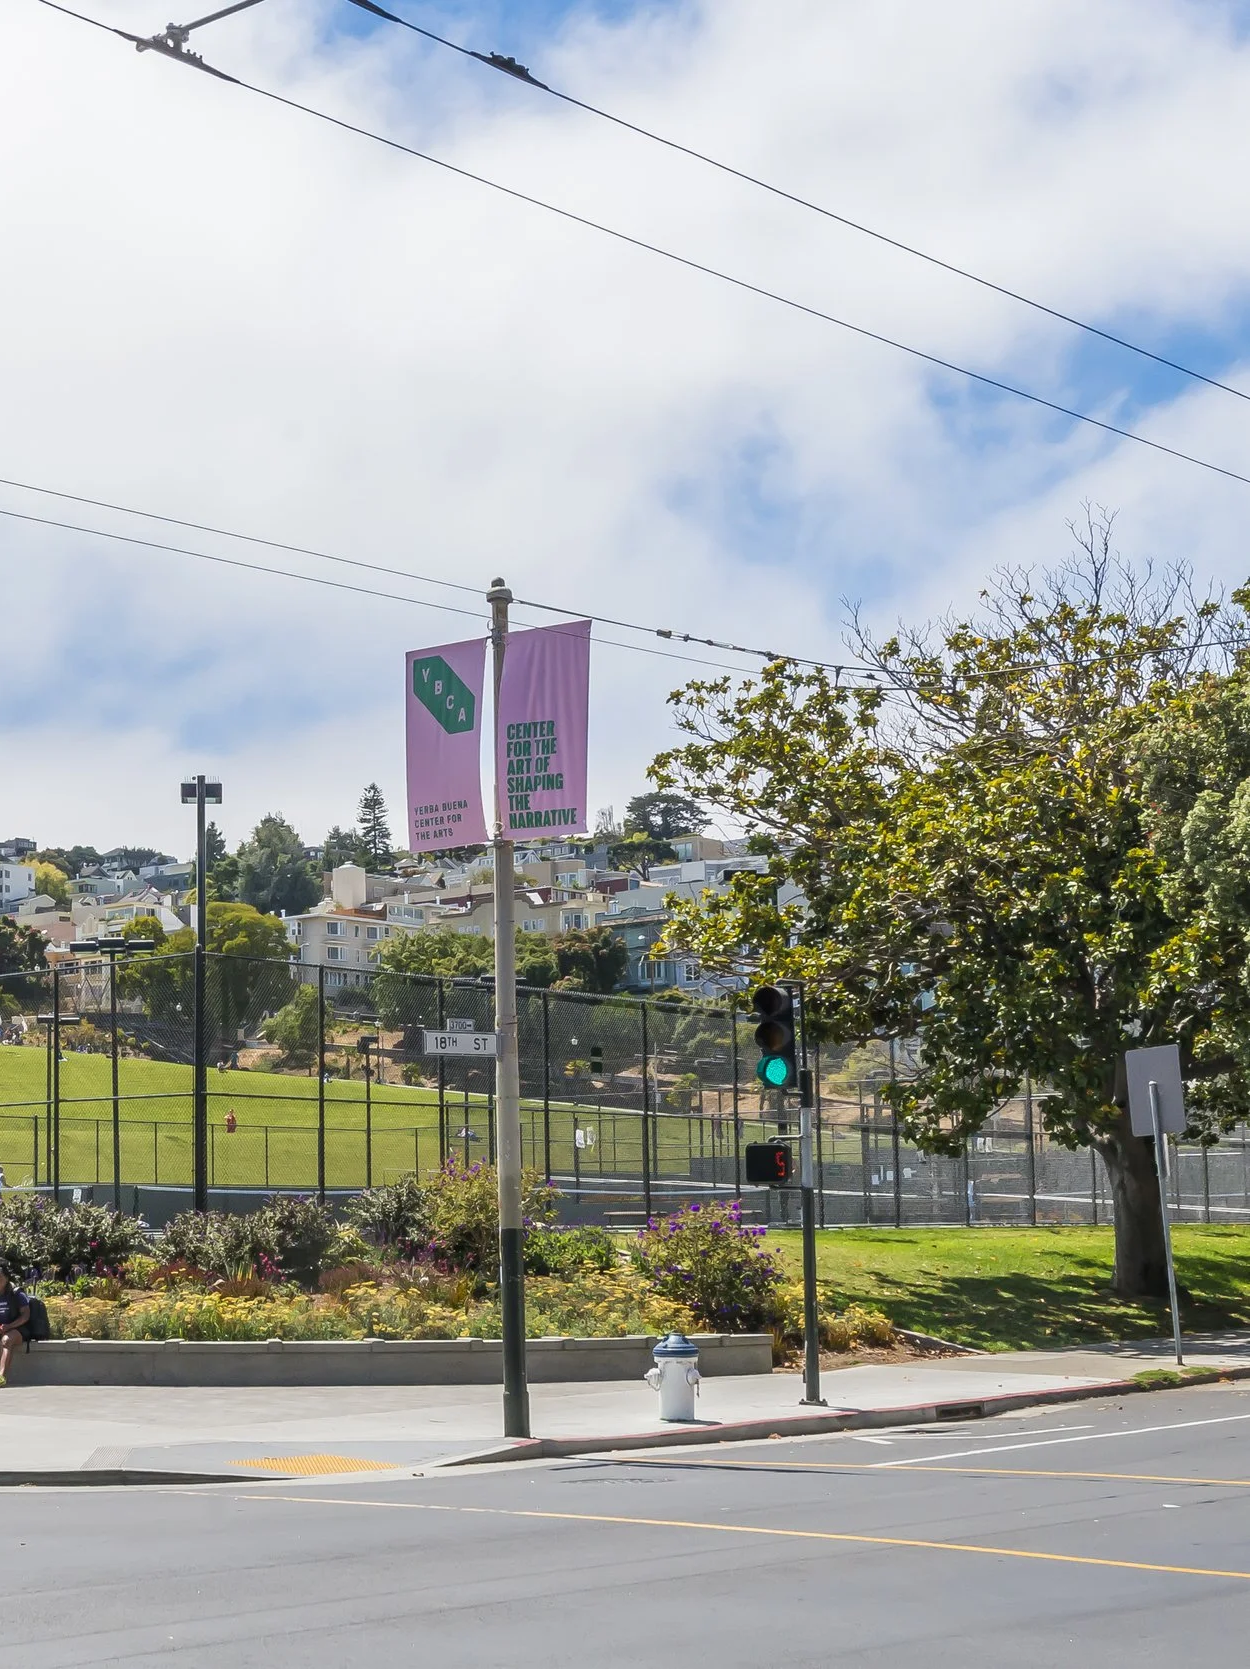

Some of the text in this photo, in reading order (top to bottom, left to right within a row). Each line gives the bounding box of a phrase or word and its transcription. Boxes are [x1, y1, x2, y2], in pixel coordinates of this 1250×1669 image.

[506, 720, 555, 740] CENTER
[506, 737, 557, 758] FOR THE
[506, 756, 551, 776] ART OF
[507, 773, 564, 794] SHAPING
[414, 800, 468, 816] YERBA BUENA
[508, 794, 531, 811] THE
[414, 813, 462, 829] CENTER FOR
[509, 807, 578, 830] NARRATIVE
[415, 828, 454, 842] THE ARTS
[434, 1036, 488, 1051] 18TH ST
